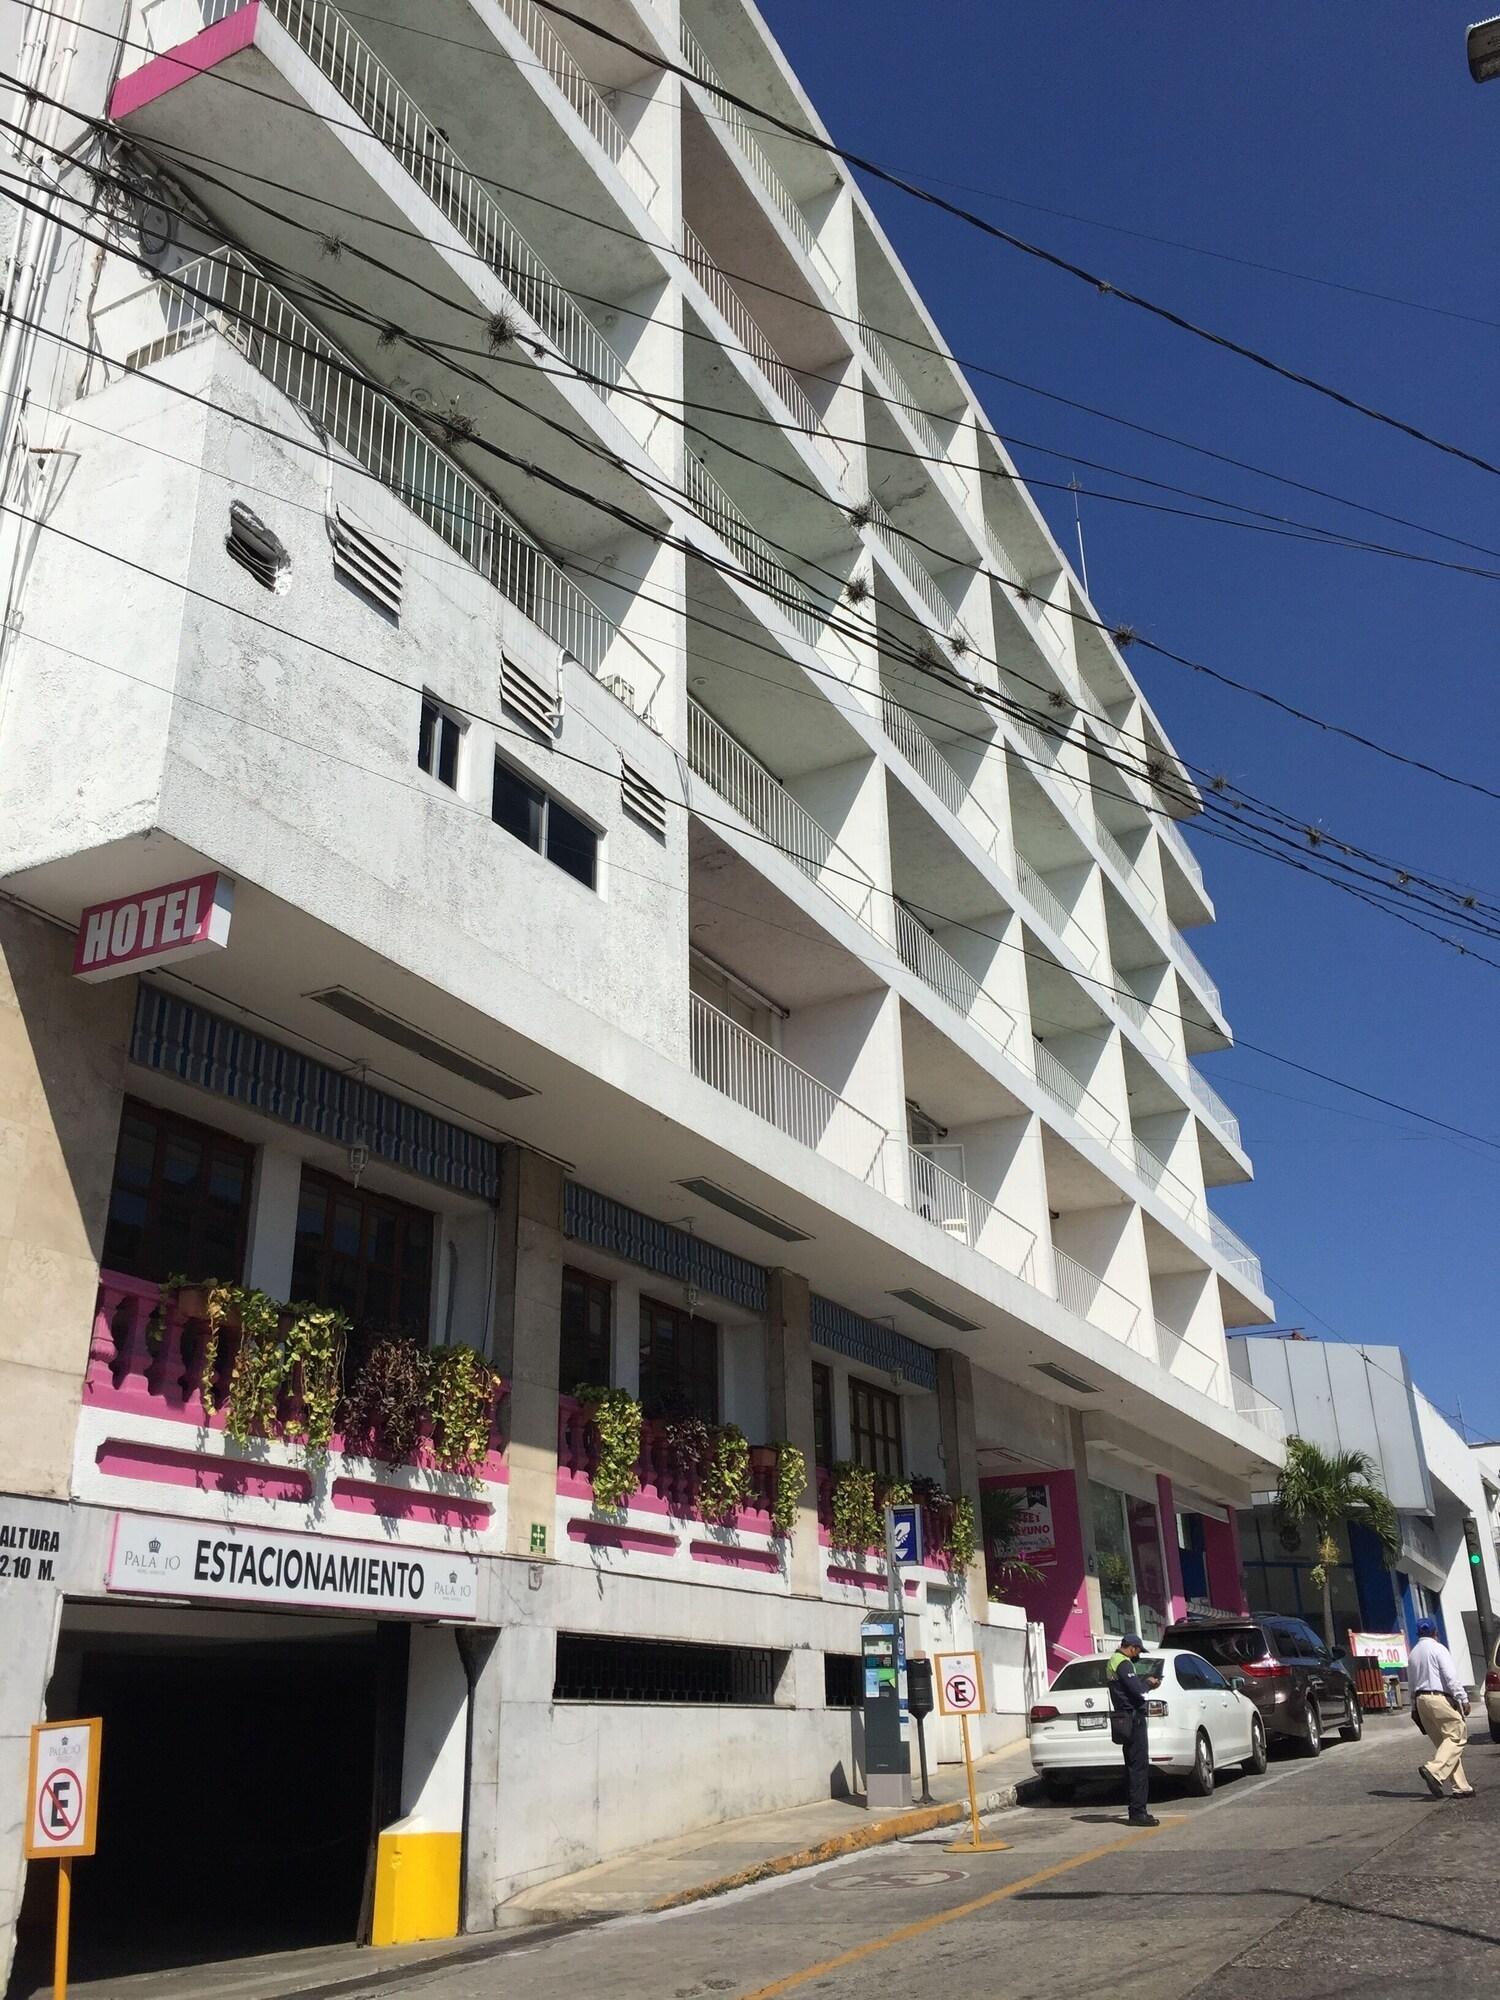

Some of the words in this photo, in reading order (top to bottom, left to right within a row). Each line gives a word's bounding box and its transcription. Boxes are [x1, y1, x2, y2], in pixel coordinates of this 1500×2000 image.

[82, 885, 202, 965] HOTEL
[0, 1525, 60, 1552] ALTURA
[0, 1554, 31, 1579] 2.10
[37, 1558, 56, 1581] M.
[194, 1539, 424, 1600] ESTACIONAMIENTO
[954, 1681, 968, 1702] E
[51, 1781, 71, 1828] E
